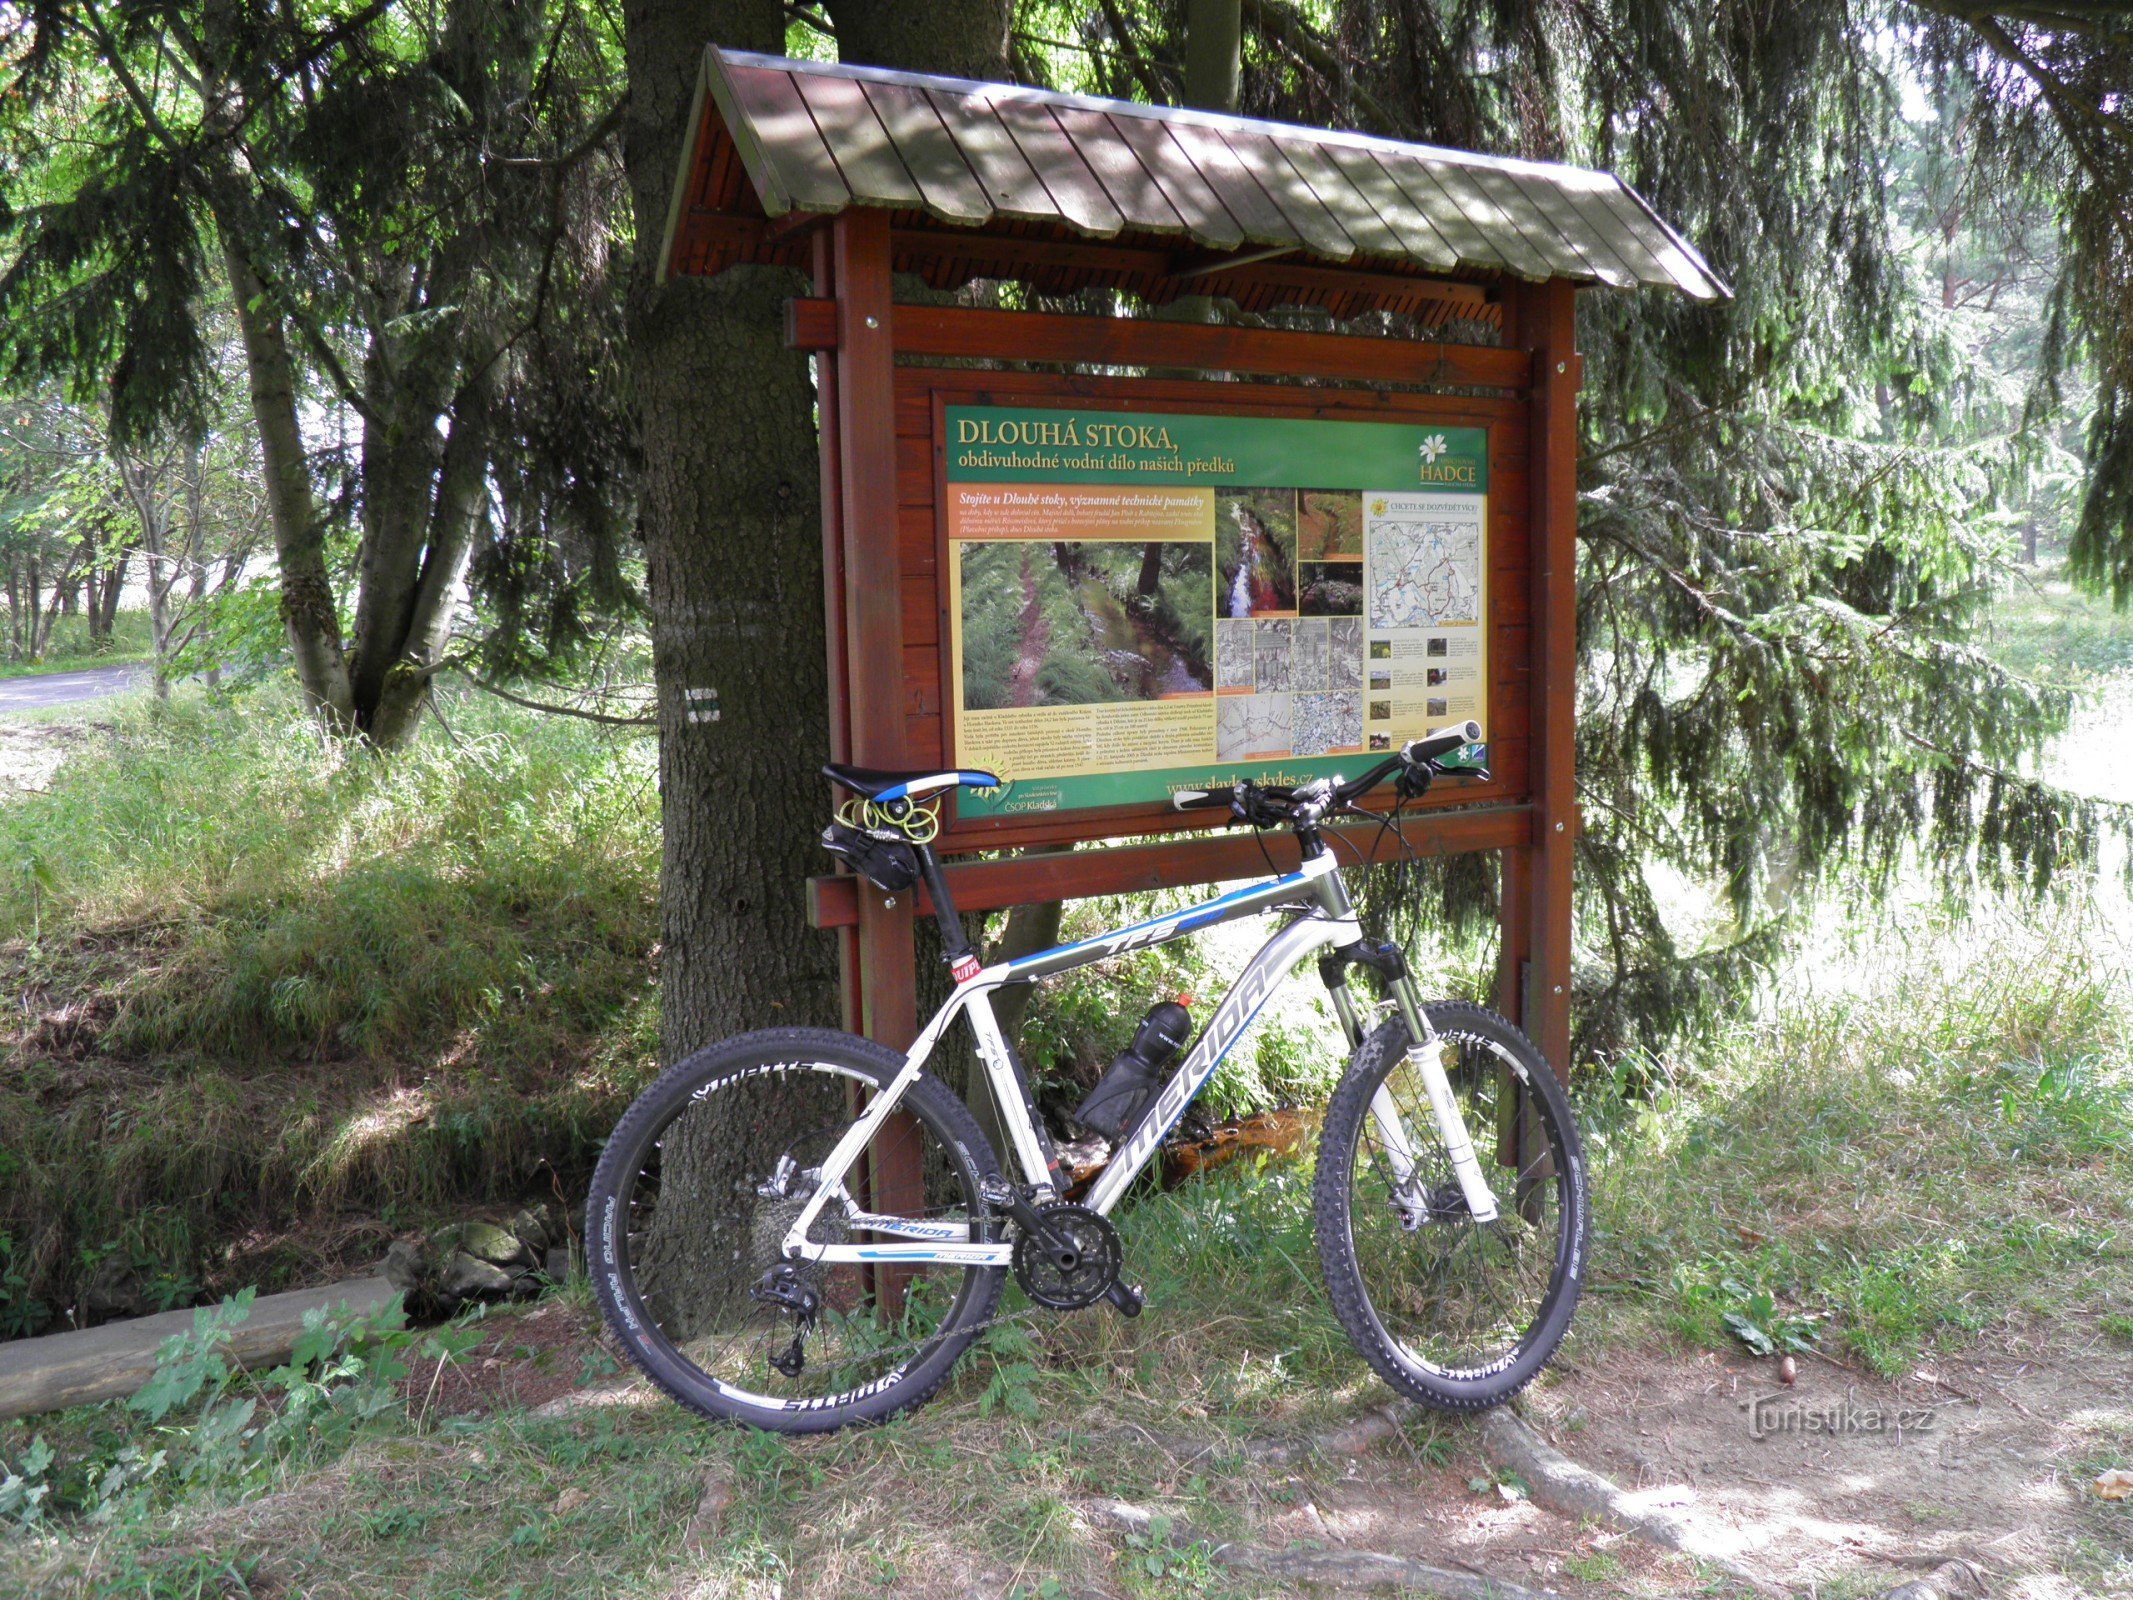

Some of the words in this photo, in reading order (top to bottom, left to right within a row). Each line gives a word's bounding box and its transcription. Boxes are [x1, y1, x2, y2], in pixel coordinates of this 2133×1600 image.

[957, 418, 1081, 447] DLOUHÁ
[1085, 424, 1180, 454] STOKA,
[958, 450, 1059, 469] obdivuhodné
[1063, 453, 1105, 470] vodní
[1108, 455, 1136, 471] dílo
[1139, 455, 1184, 472] našich
[1187, 456, 1235, 477] předků
[1421, 465, 1476, 482] HADCE
[960, 492, 991, 507] Stojíte
[993, 495, 1000, 505] u
[1002, 492, 1040, 505] Dlouhé
[1040, 493, 1068, 508] stoky,
[1070, 494, 1120, 509] významné
[1122, 494, 1163, 506] technické
[1163, 494, 1204, 511] památky
[1004, 801, 1026, 812] ČSOP
[1027, 799, 1057, 811] Kladská
[1124, 966, 1266, 1173] MERIDA
[602, 1195, 617, 1265] RACING
[1567, 1154, 1586, 1281] SCHWALBE
[606, 1272, 639, 1331] RALPH
